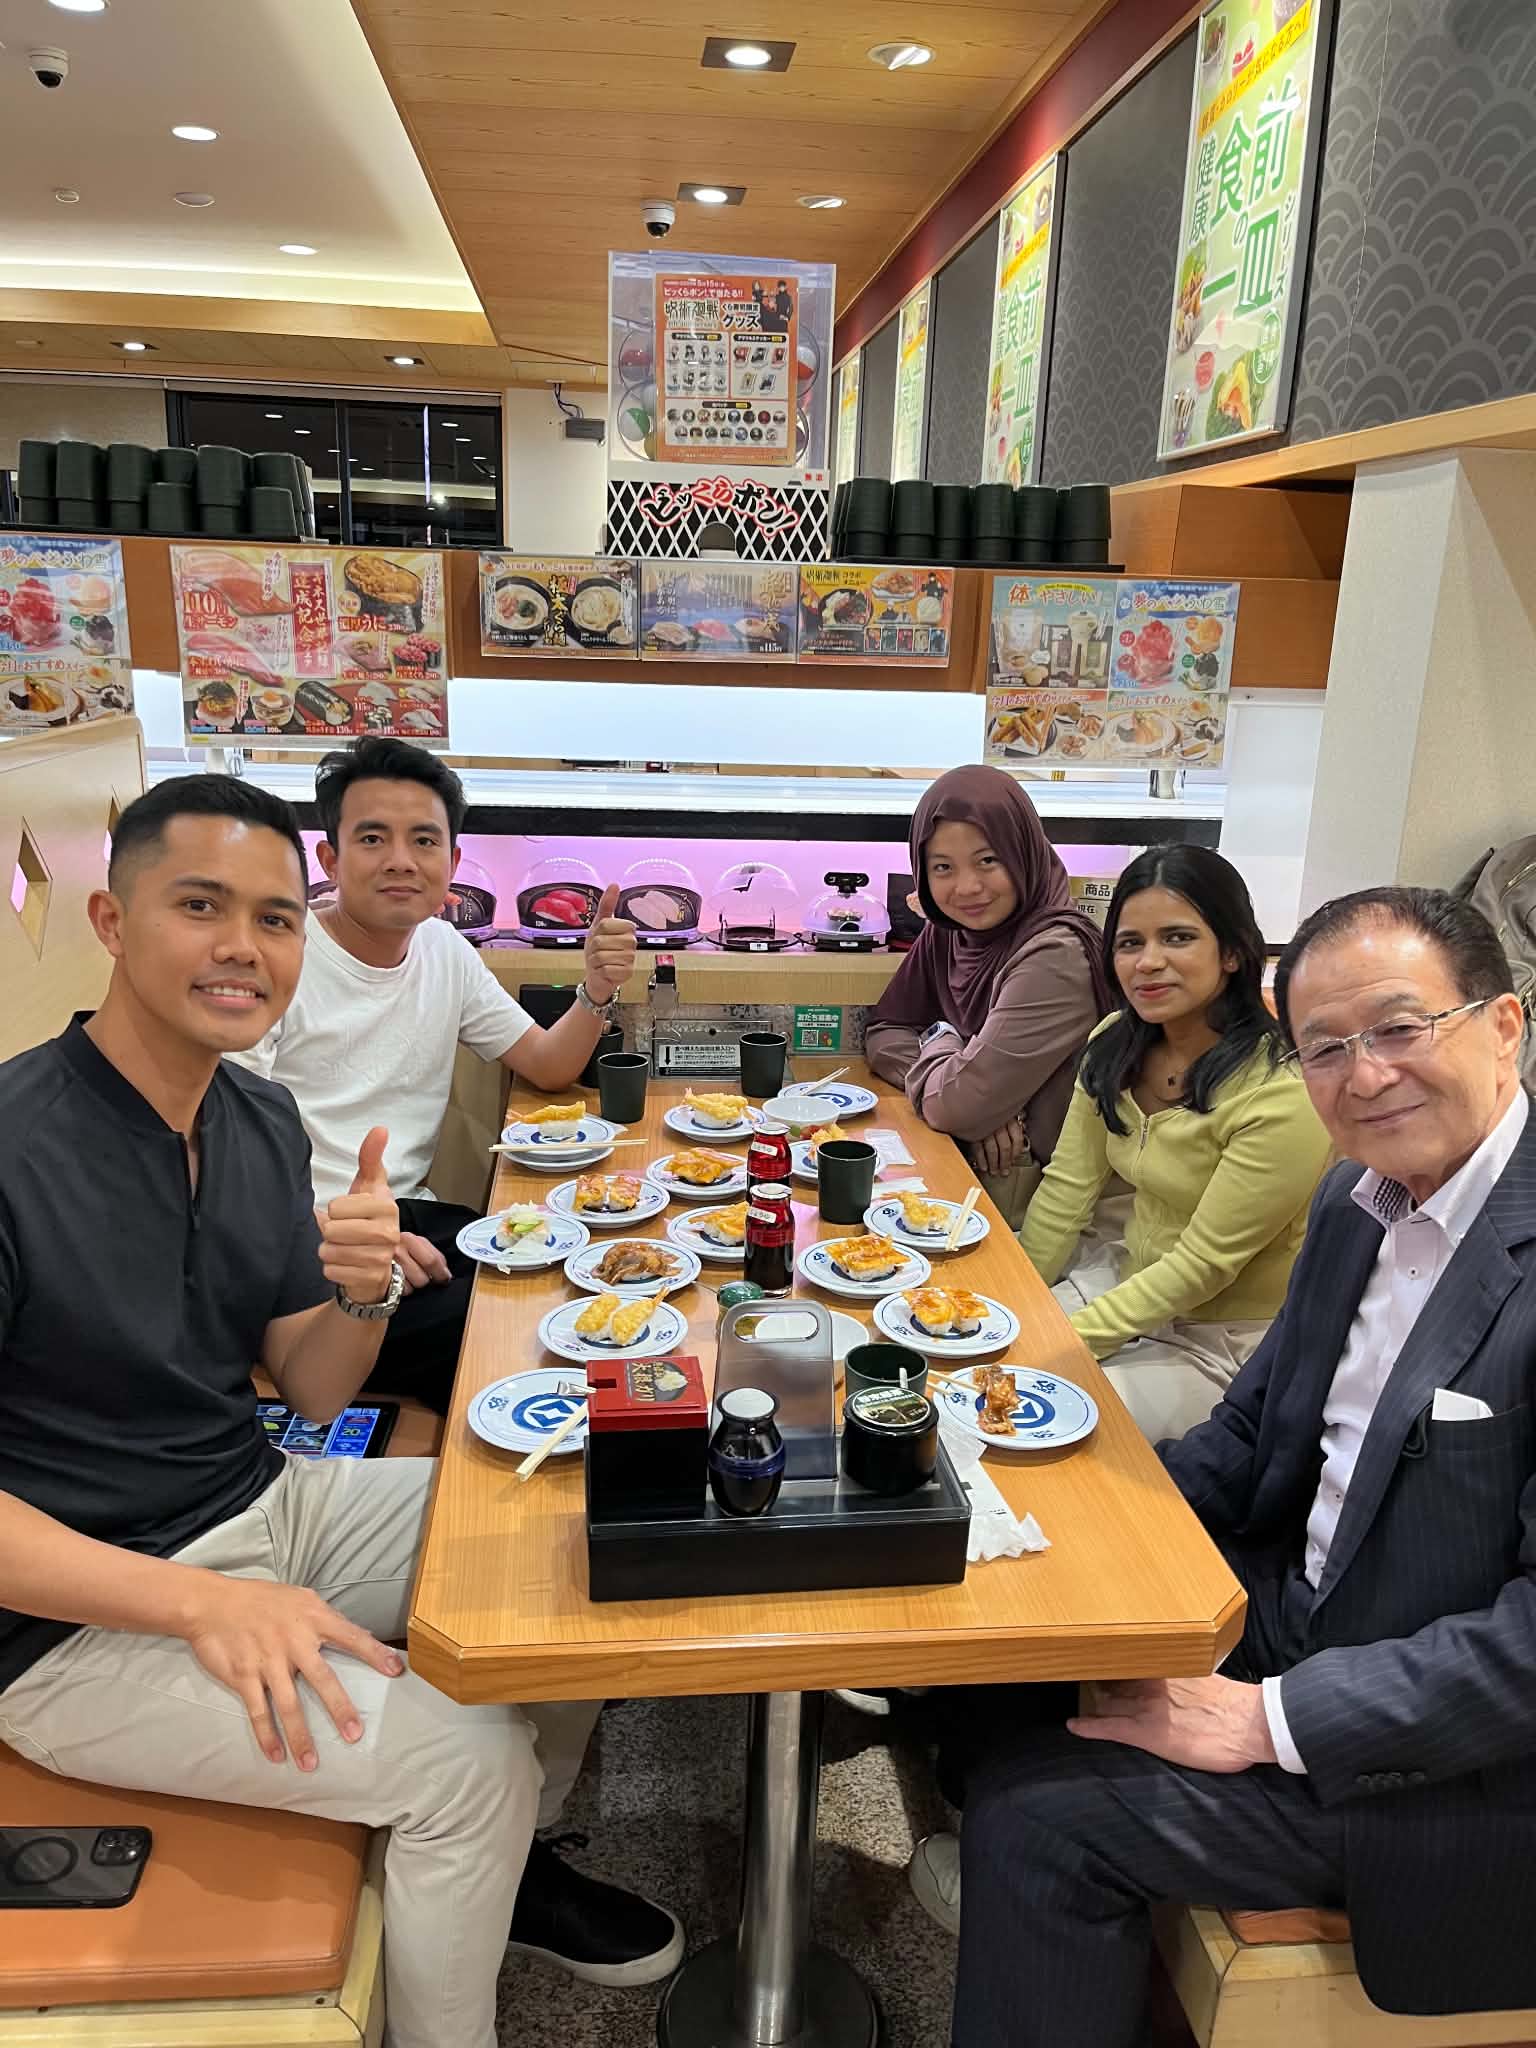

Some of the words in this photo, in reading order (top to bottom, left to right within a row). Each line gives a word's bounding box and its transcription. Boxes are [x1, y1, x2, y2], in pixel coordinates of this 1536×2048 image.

[1190, 136, 1216, 246] 健康
[1273, 196, 1296, 299] シリーズ
[1009, 583, 1032, 605] 体
[1085, 883, 1110, 897] 商品
